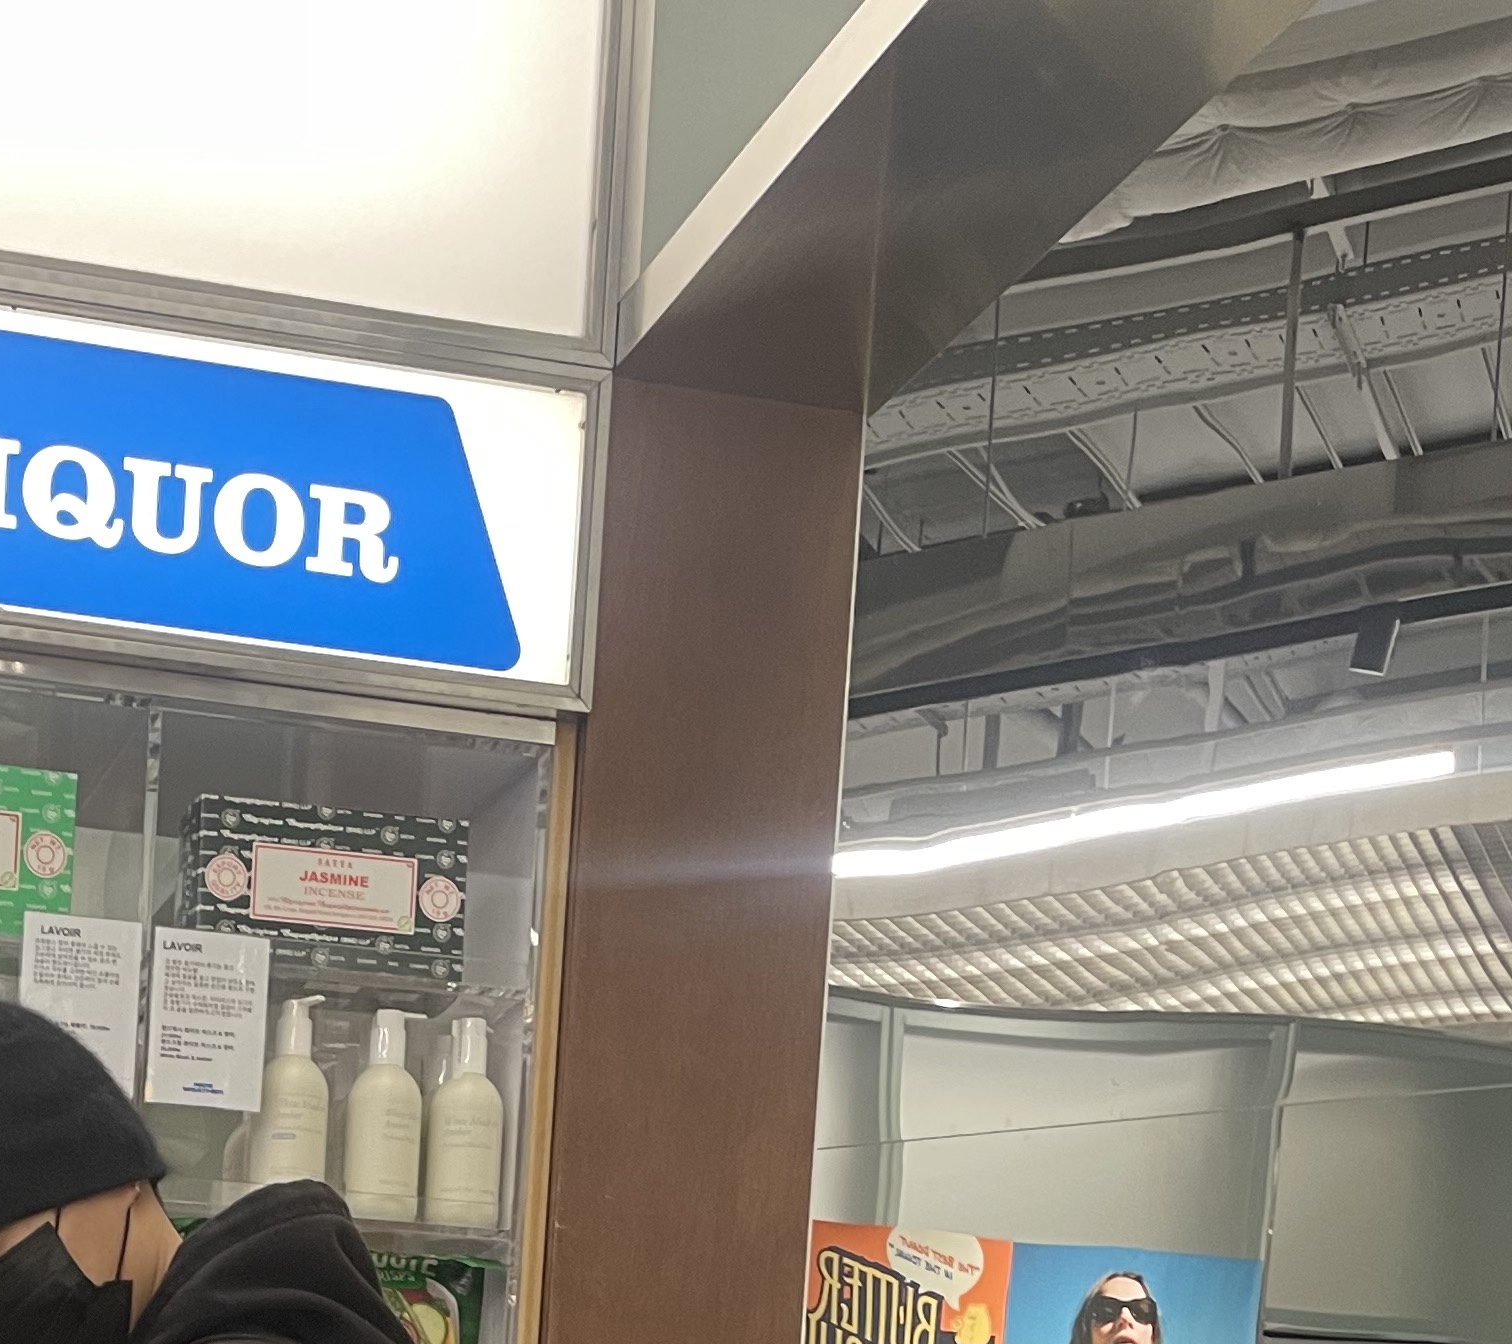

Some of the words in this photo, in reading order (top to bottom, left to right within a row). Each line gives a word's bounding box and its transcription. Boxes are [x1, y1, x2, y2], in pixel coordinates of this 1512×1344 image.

[299, 870, 370, 889] JASMINE
[303, 884, 366, 901] INCENSE
[40, 924, 82, 938] LAVOIR
[162, 940, 203, 953] LAVOIR
